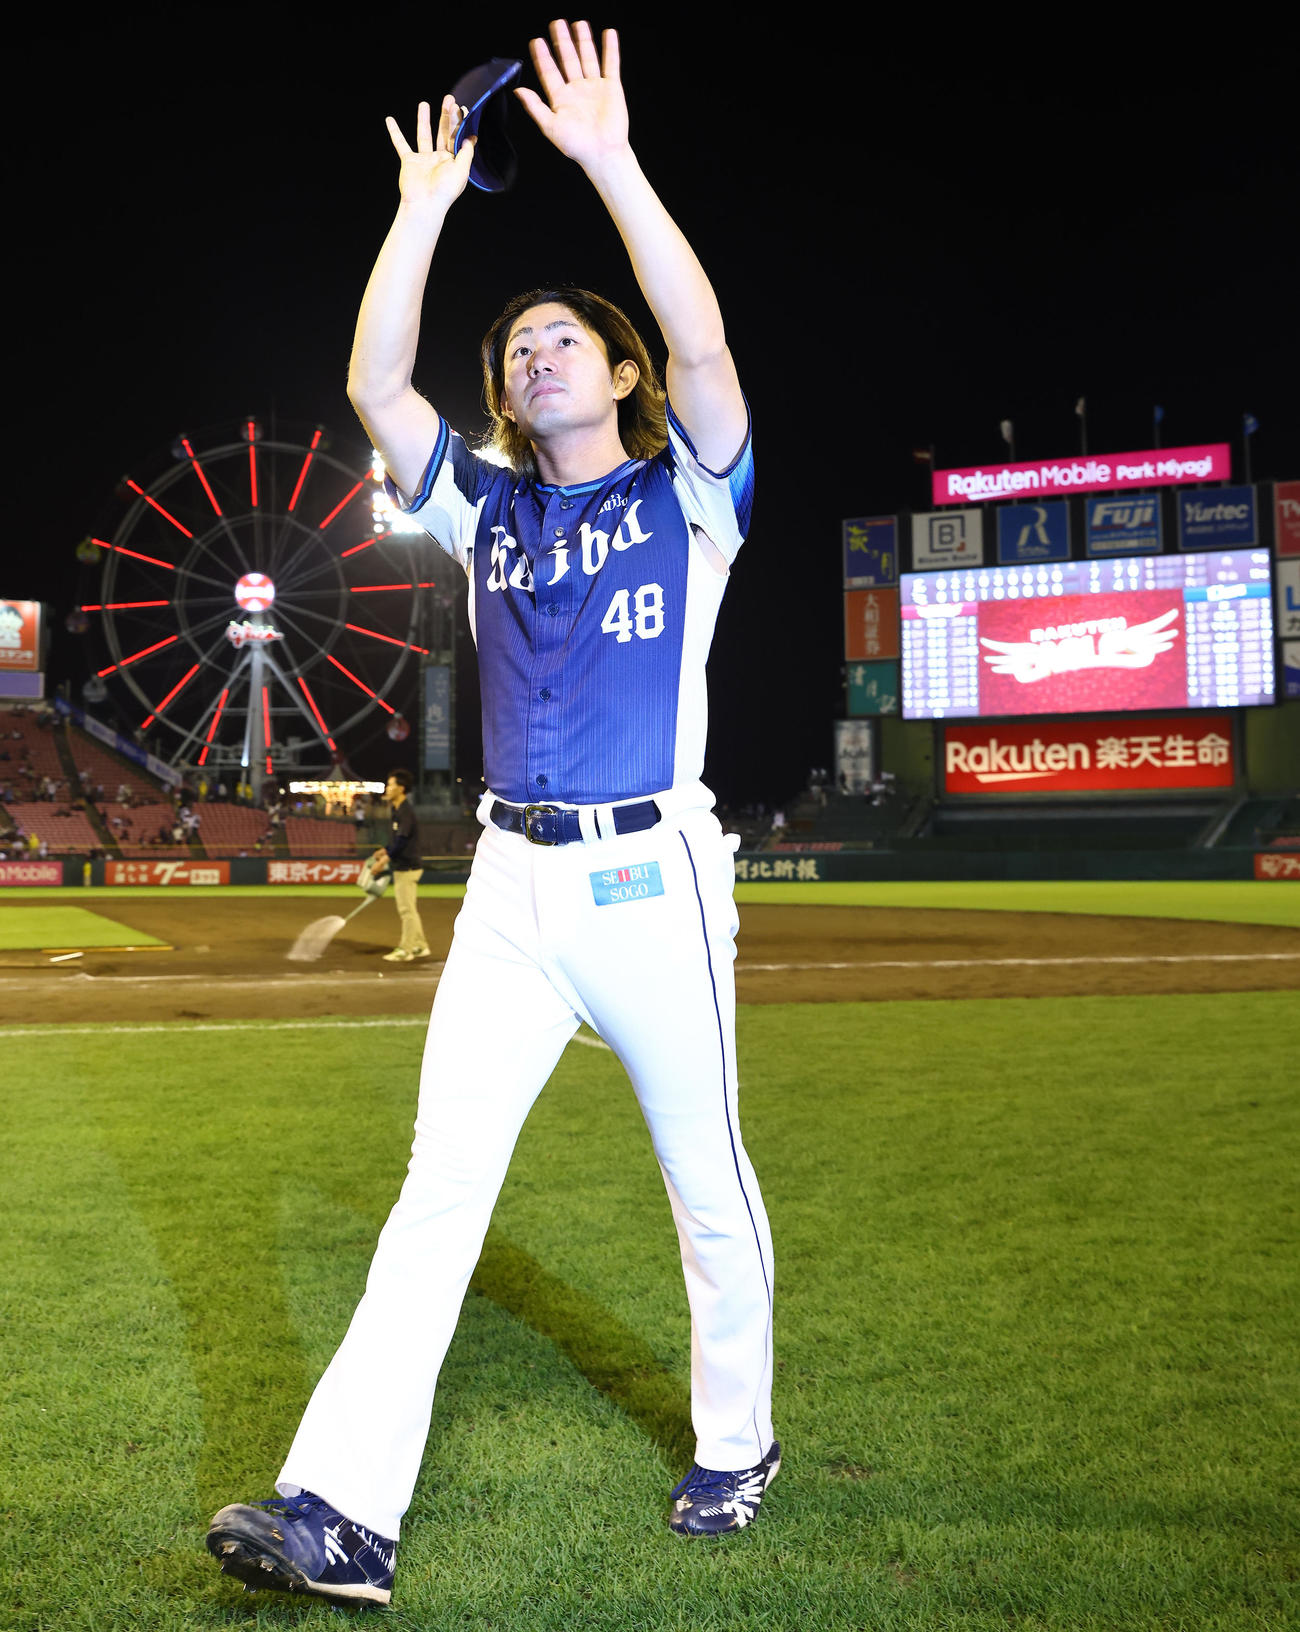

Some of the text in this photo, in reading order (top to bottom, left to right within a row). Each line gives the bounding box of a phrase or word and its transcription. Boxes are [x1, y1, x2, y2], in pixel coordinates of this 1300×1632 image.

[948, 455, 1213, 497] Rakuten Mobile Park Miyagi
[1092, 499, 1155, 528] Fuji
[1185, 501, 1249, 523] Yurtec
[601, 582, 665, 643] 48
[946, 732, 1229, 773] Rakuten 楽天生命
[7, 866, 58, 882] Mobile
[602, 865, 649, 886] SEIBU
[610, 883, 649, 901] SOGO
